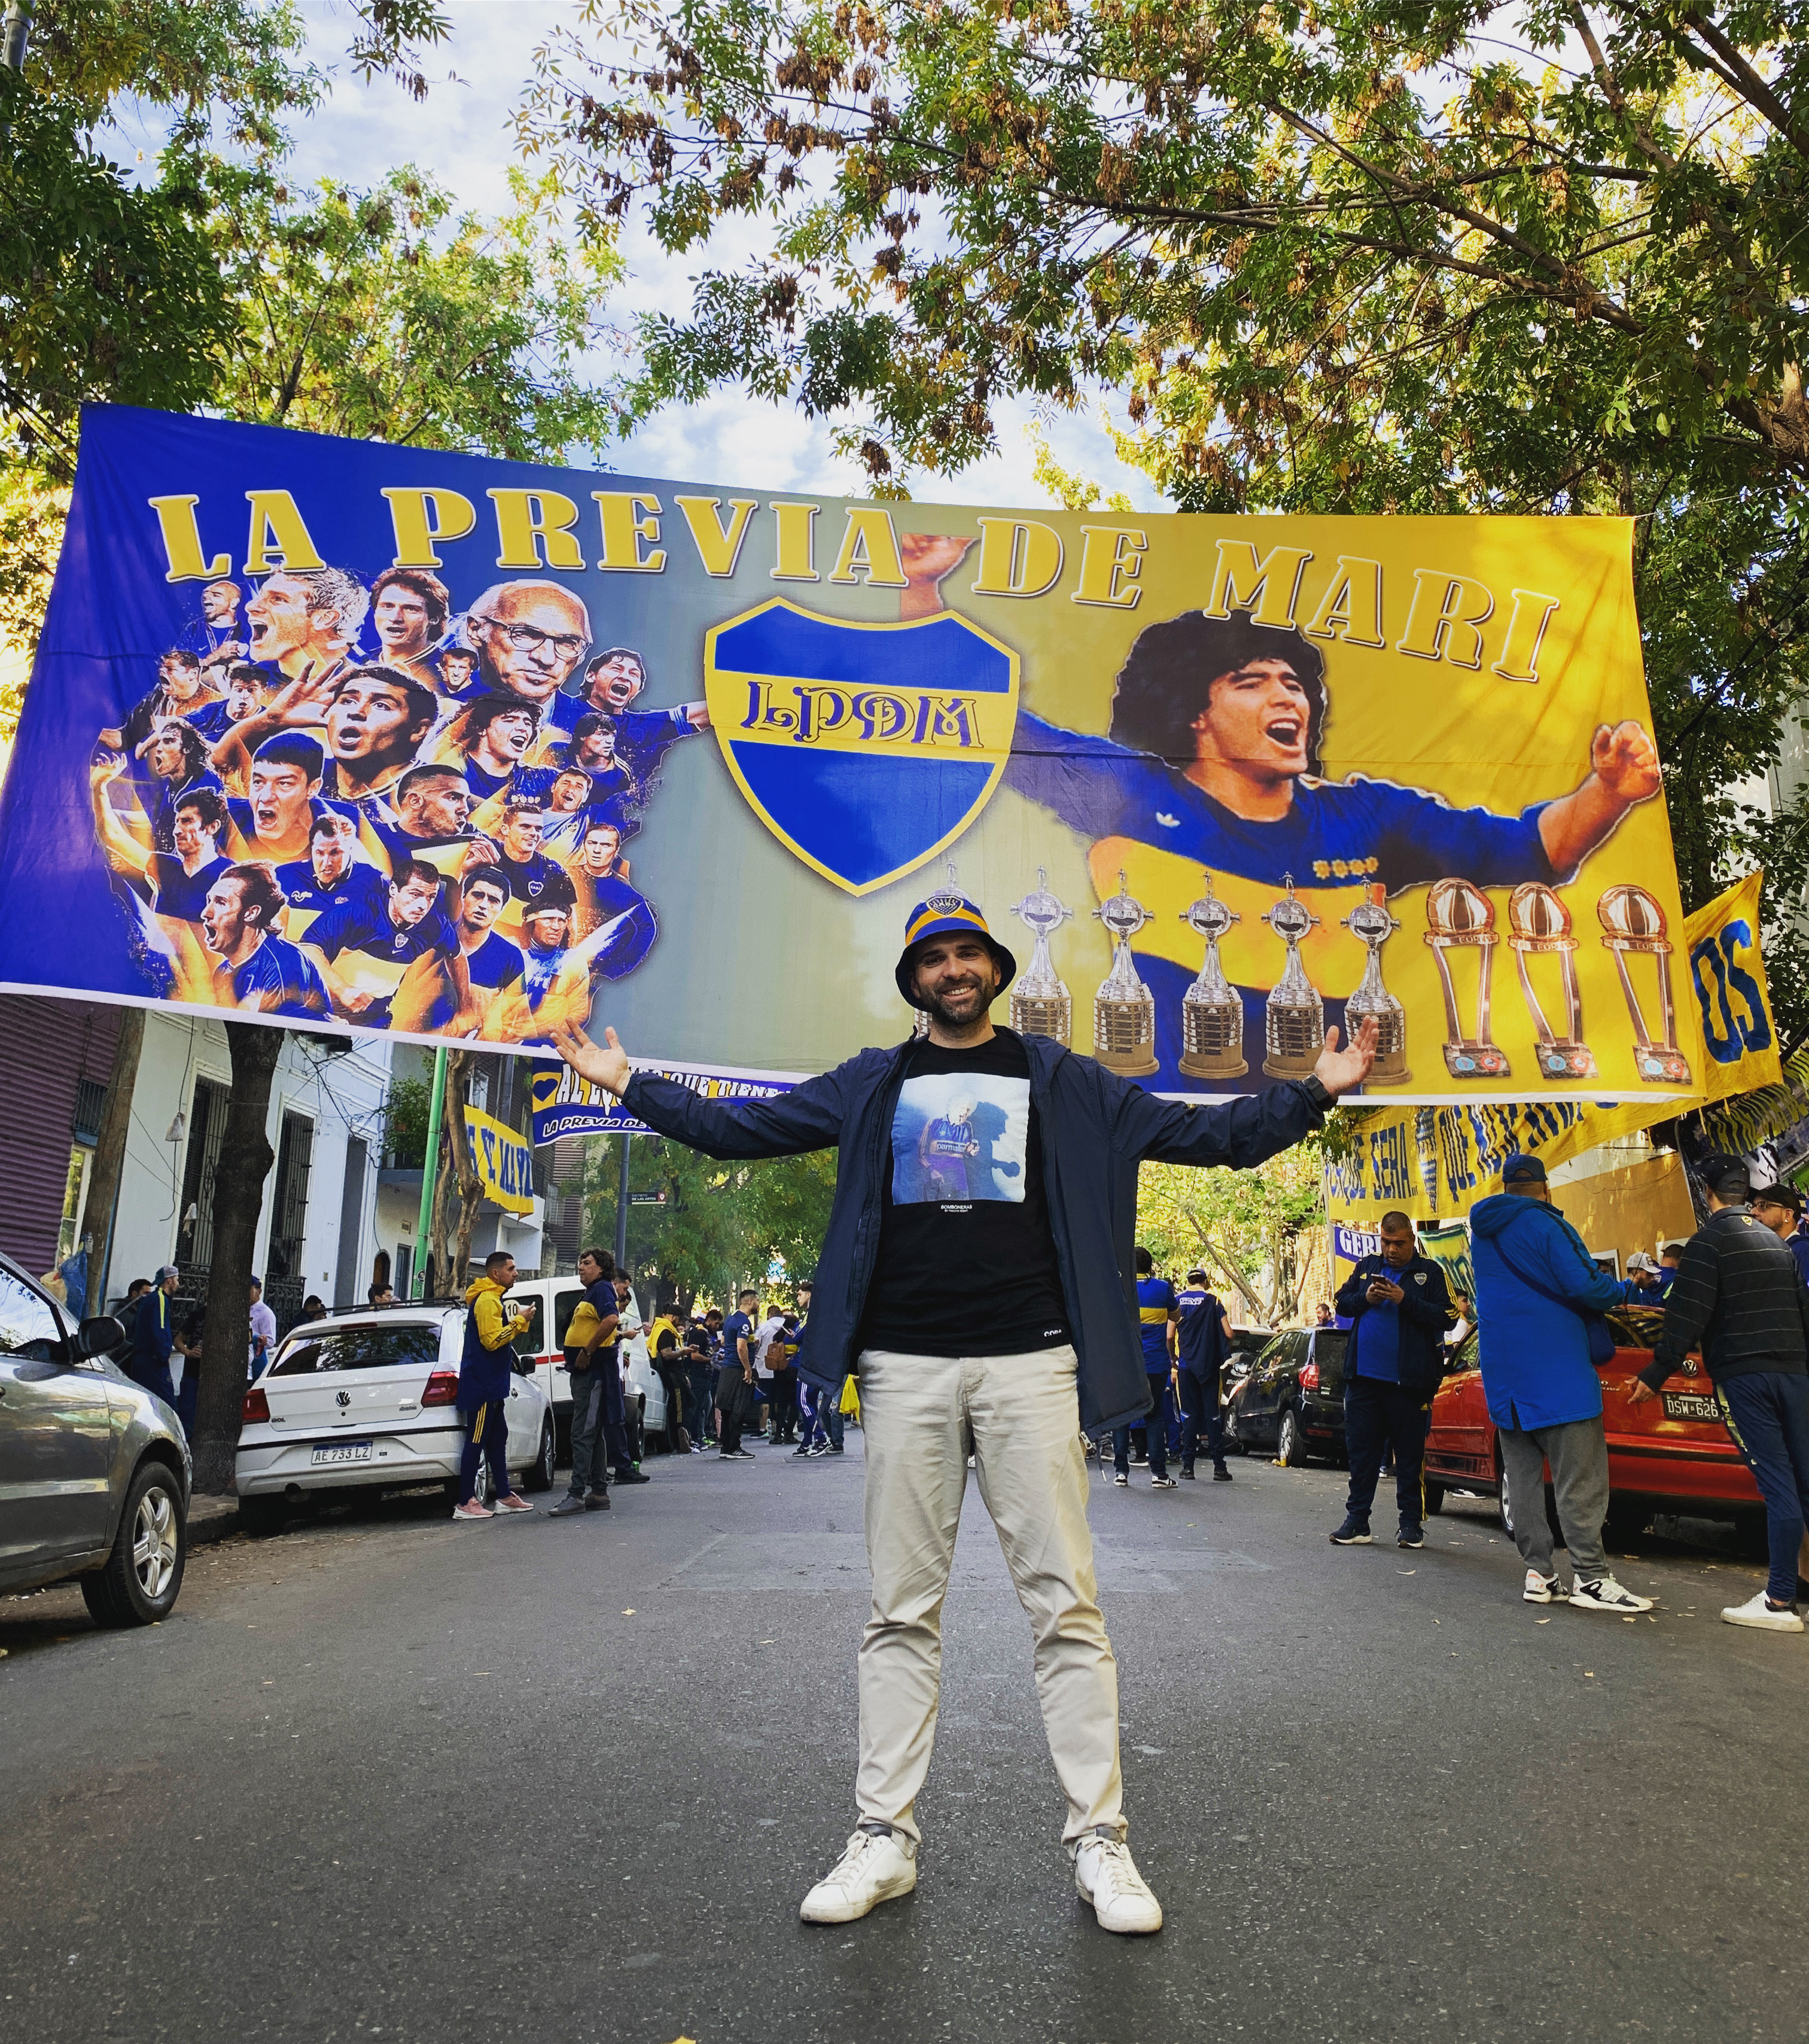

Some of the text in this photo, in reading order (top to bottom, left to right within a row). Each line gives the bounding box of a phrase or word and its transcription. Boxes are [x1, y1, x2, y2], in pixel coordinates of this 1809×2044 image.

[148, 488, 1560, 682] LA PREVIA DE MARI
[742, 682, 984, 749] LPDM
[555, 1063, 584, 1105] AL
[670, 1072, 711, 1098] QUE
[718, 1079, 779, 1099] TIENE
[543, 1115, 647, 1137] LA PREVIA DE
[936, 1143, 966, 1152] parmala
[1180, 1297, 1204, 1305] SEVE
[1667, 1400, 1719, 1417] DSW 626
[314, 1447, 369, 1462] AE 733 LZ
